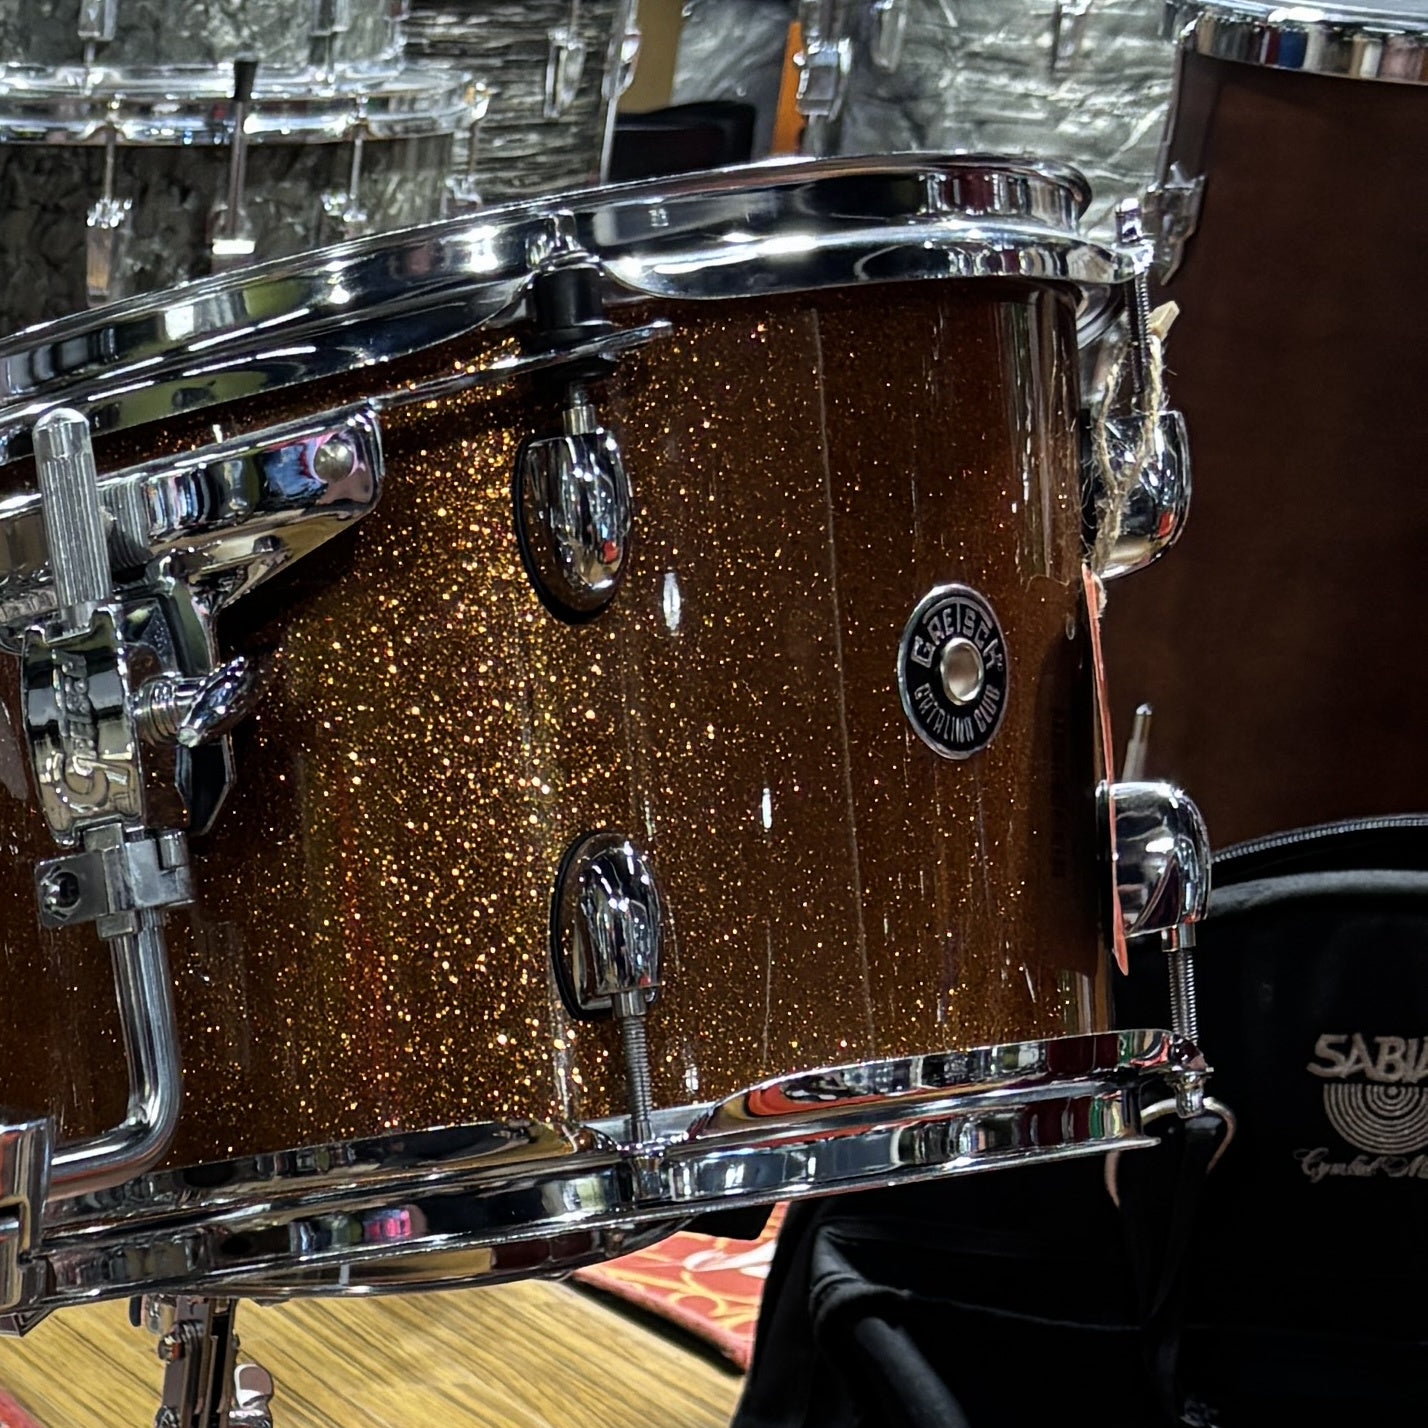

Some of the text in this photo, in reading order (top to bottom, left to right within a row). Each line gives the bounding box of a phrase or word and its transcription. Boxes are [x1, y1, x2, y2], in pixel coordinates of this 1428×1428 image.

[910, 597, 998, 669] GRETSCH
[914, 683, 1001, 743] CATALINA CLUB
